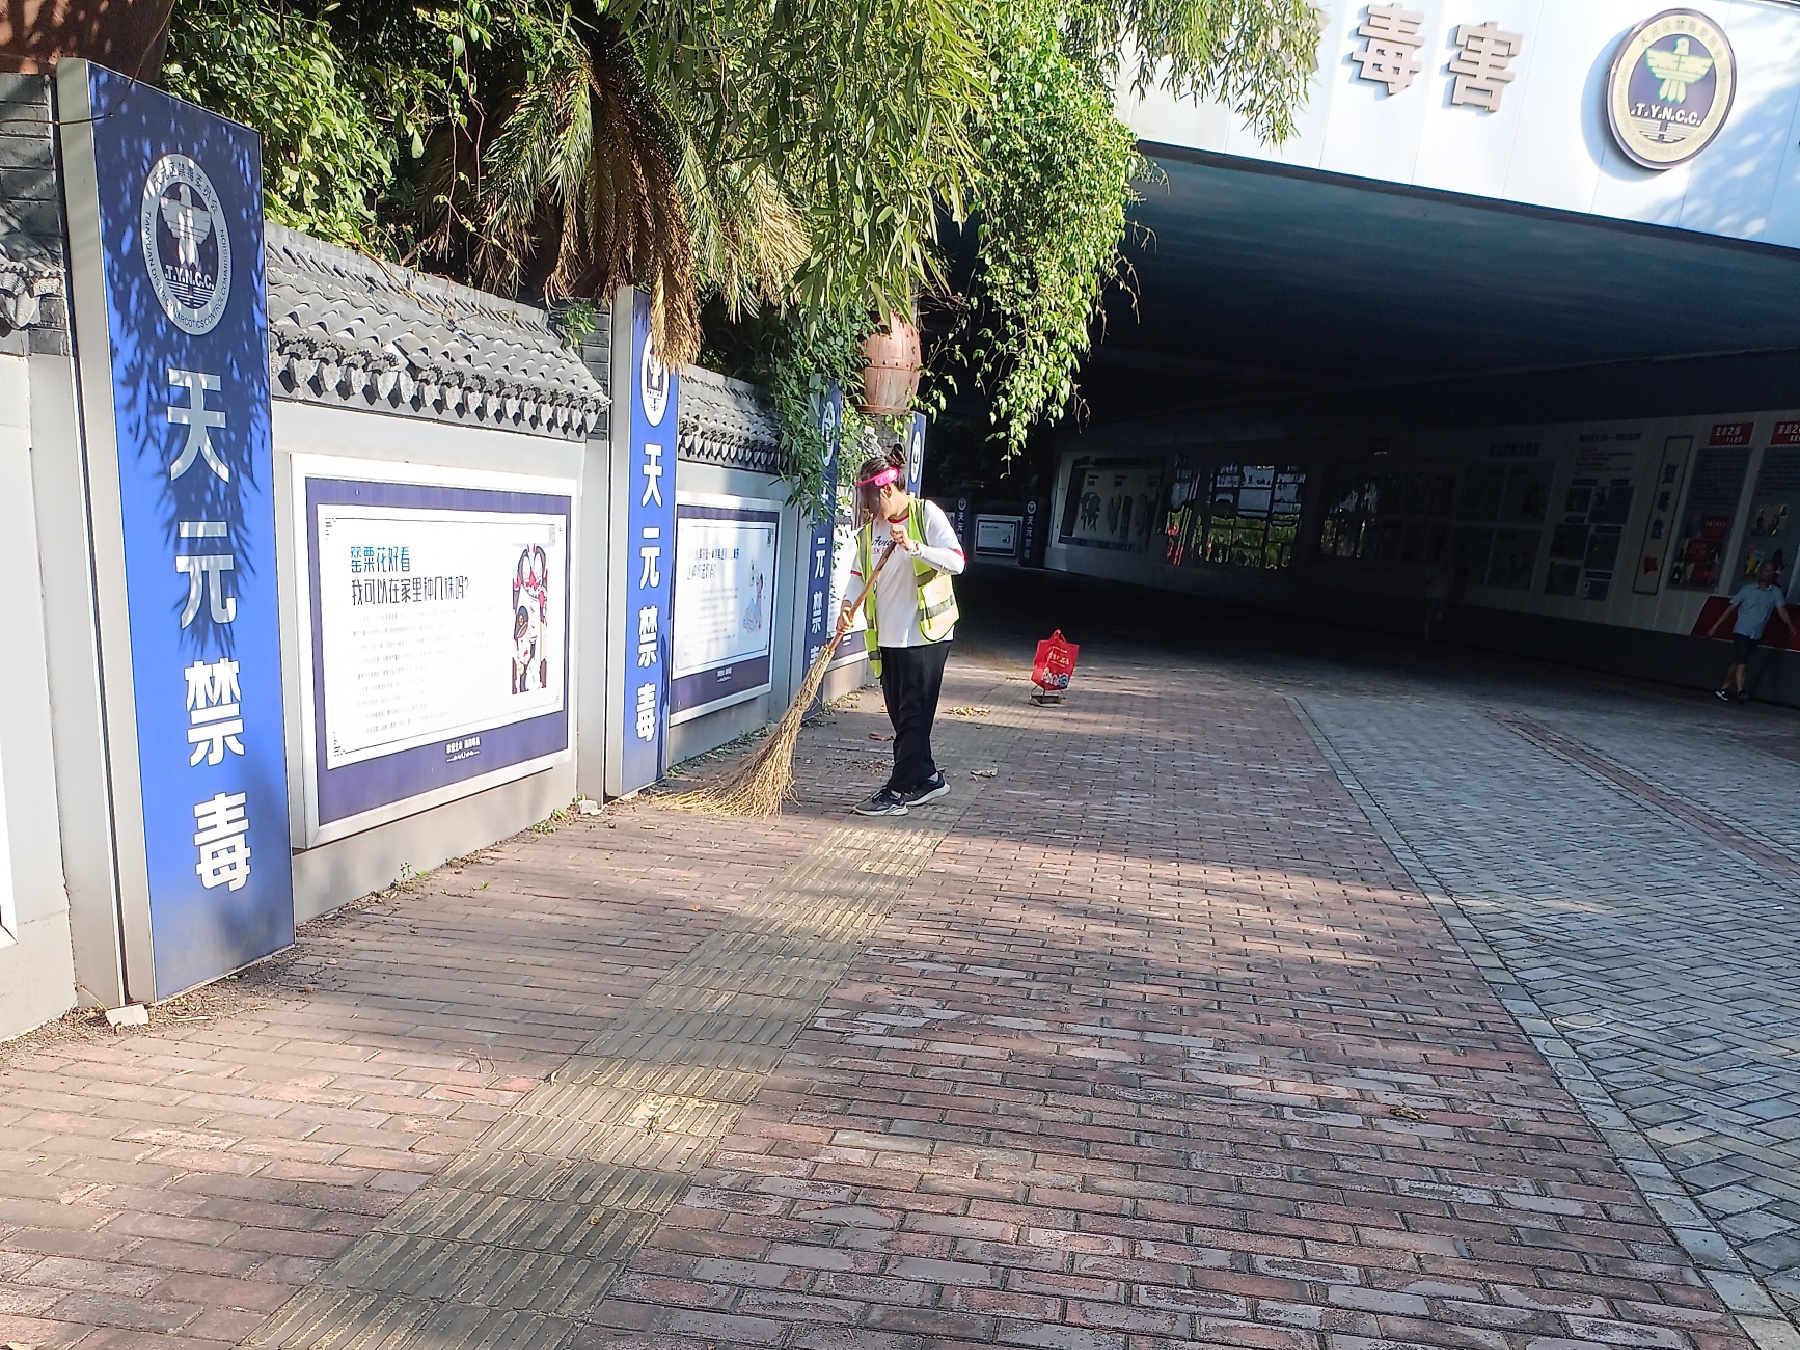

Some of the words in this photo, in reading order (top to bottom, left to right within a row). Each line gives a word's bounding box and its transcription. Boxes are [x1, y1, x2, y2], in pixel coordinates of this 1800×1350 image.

[1352, 2, 1524, 113] 毒害
[167, 368, 252, 893] 天元禁毒
[350, 546, 411, 573] 罂粟花好看
[636, 443, 664, 742] 天元禁毒
